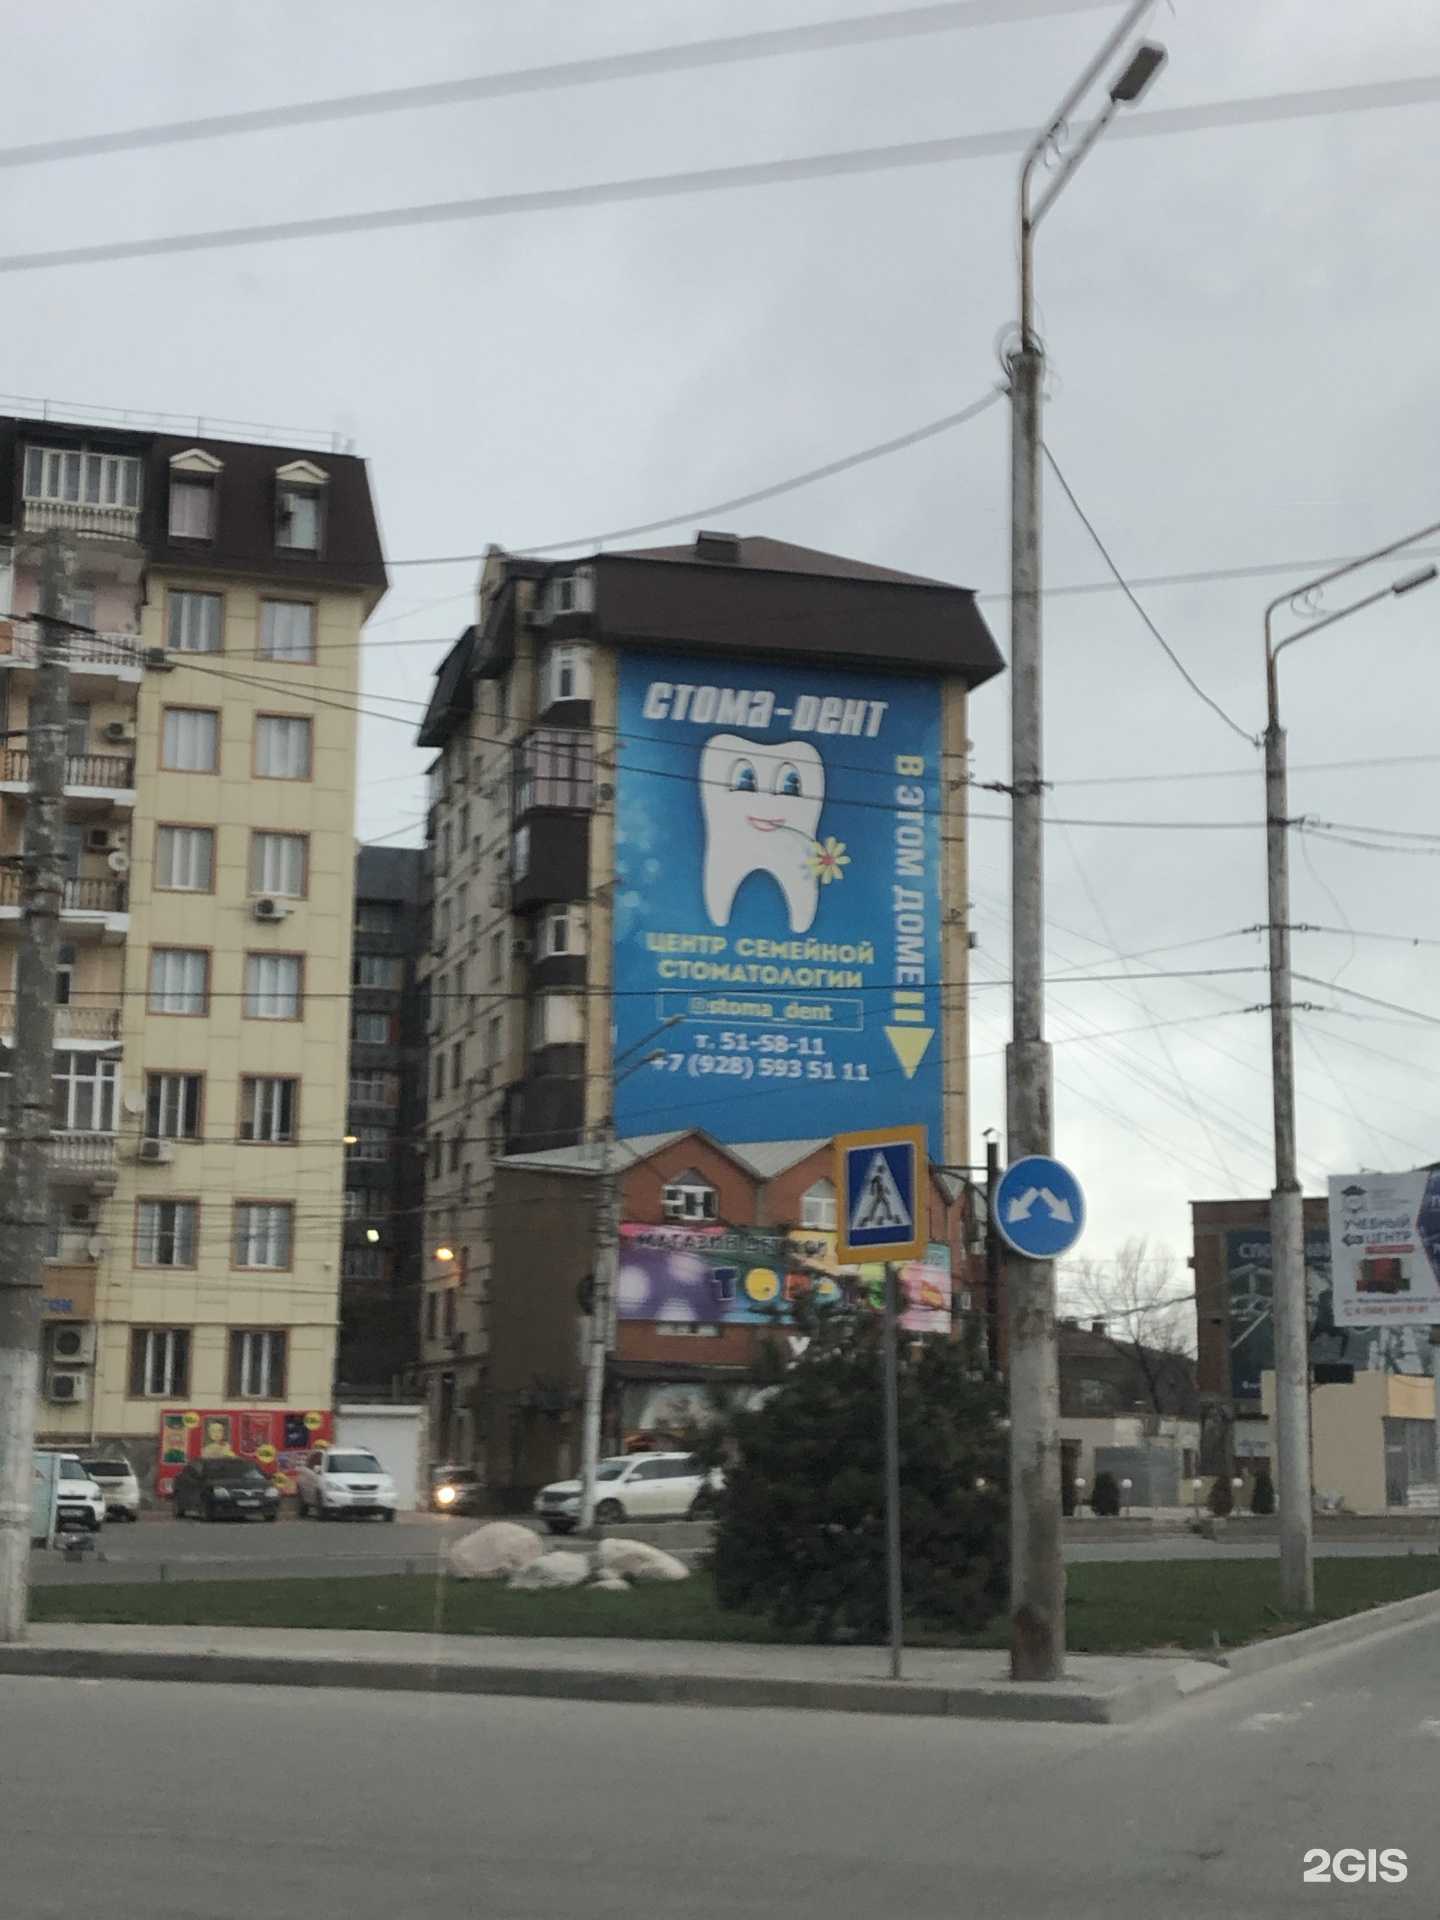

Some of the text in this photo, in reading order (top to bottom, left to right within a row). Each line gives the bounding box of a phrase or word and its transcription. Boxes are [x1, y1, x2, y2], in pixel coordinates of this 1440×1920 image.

[893, 755, 925, 985] В ЭТОМ ДОМЕ
[647, 933, 874, 964] ЦЕНТР СЕМЕЙНОЙ
[657, 959, 863, 988] СТОМАТОЛОГИИ
[719, 1032, 826, 1055] 51-58-11
[688, 1053, 754, 1079] (928)
[758, 1058, 803, 1079] 593
[806, 1061, 836, 1080] 51
[842, 1063, 870, 1082] 11
